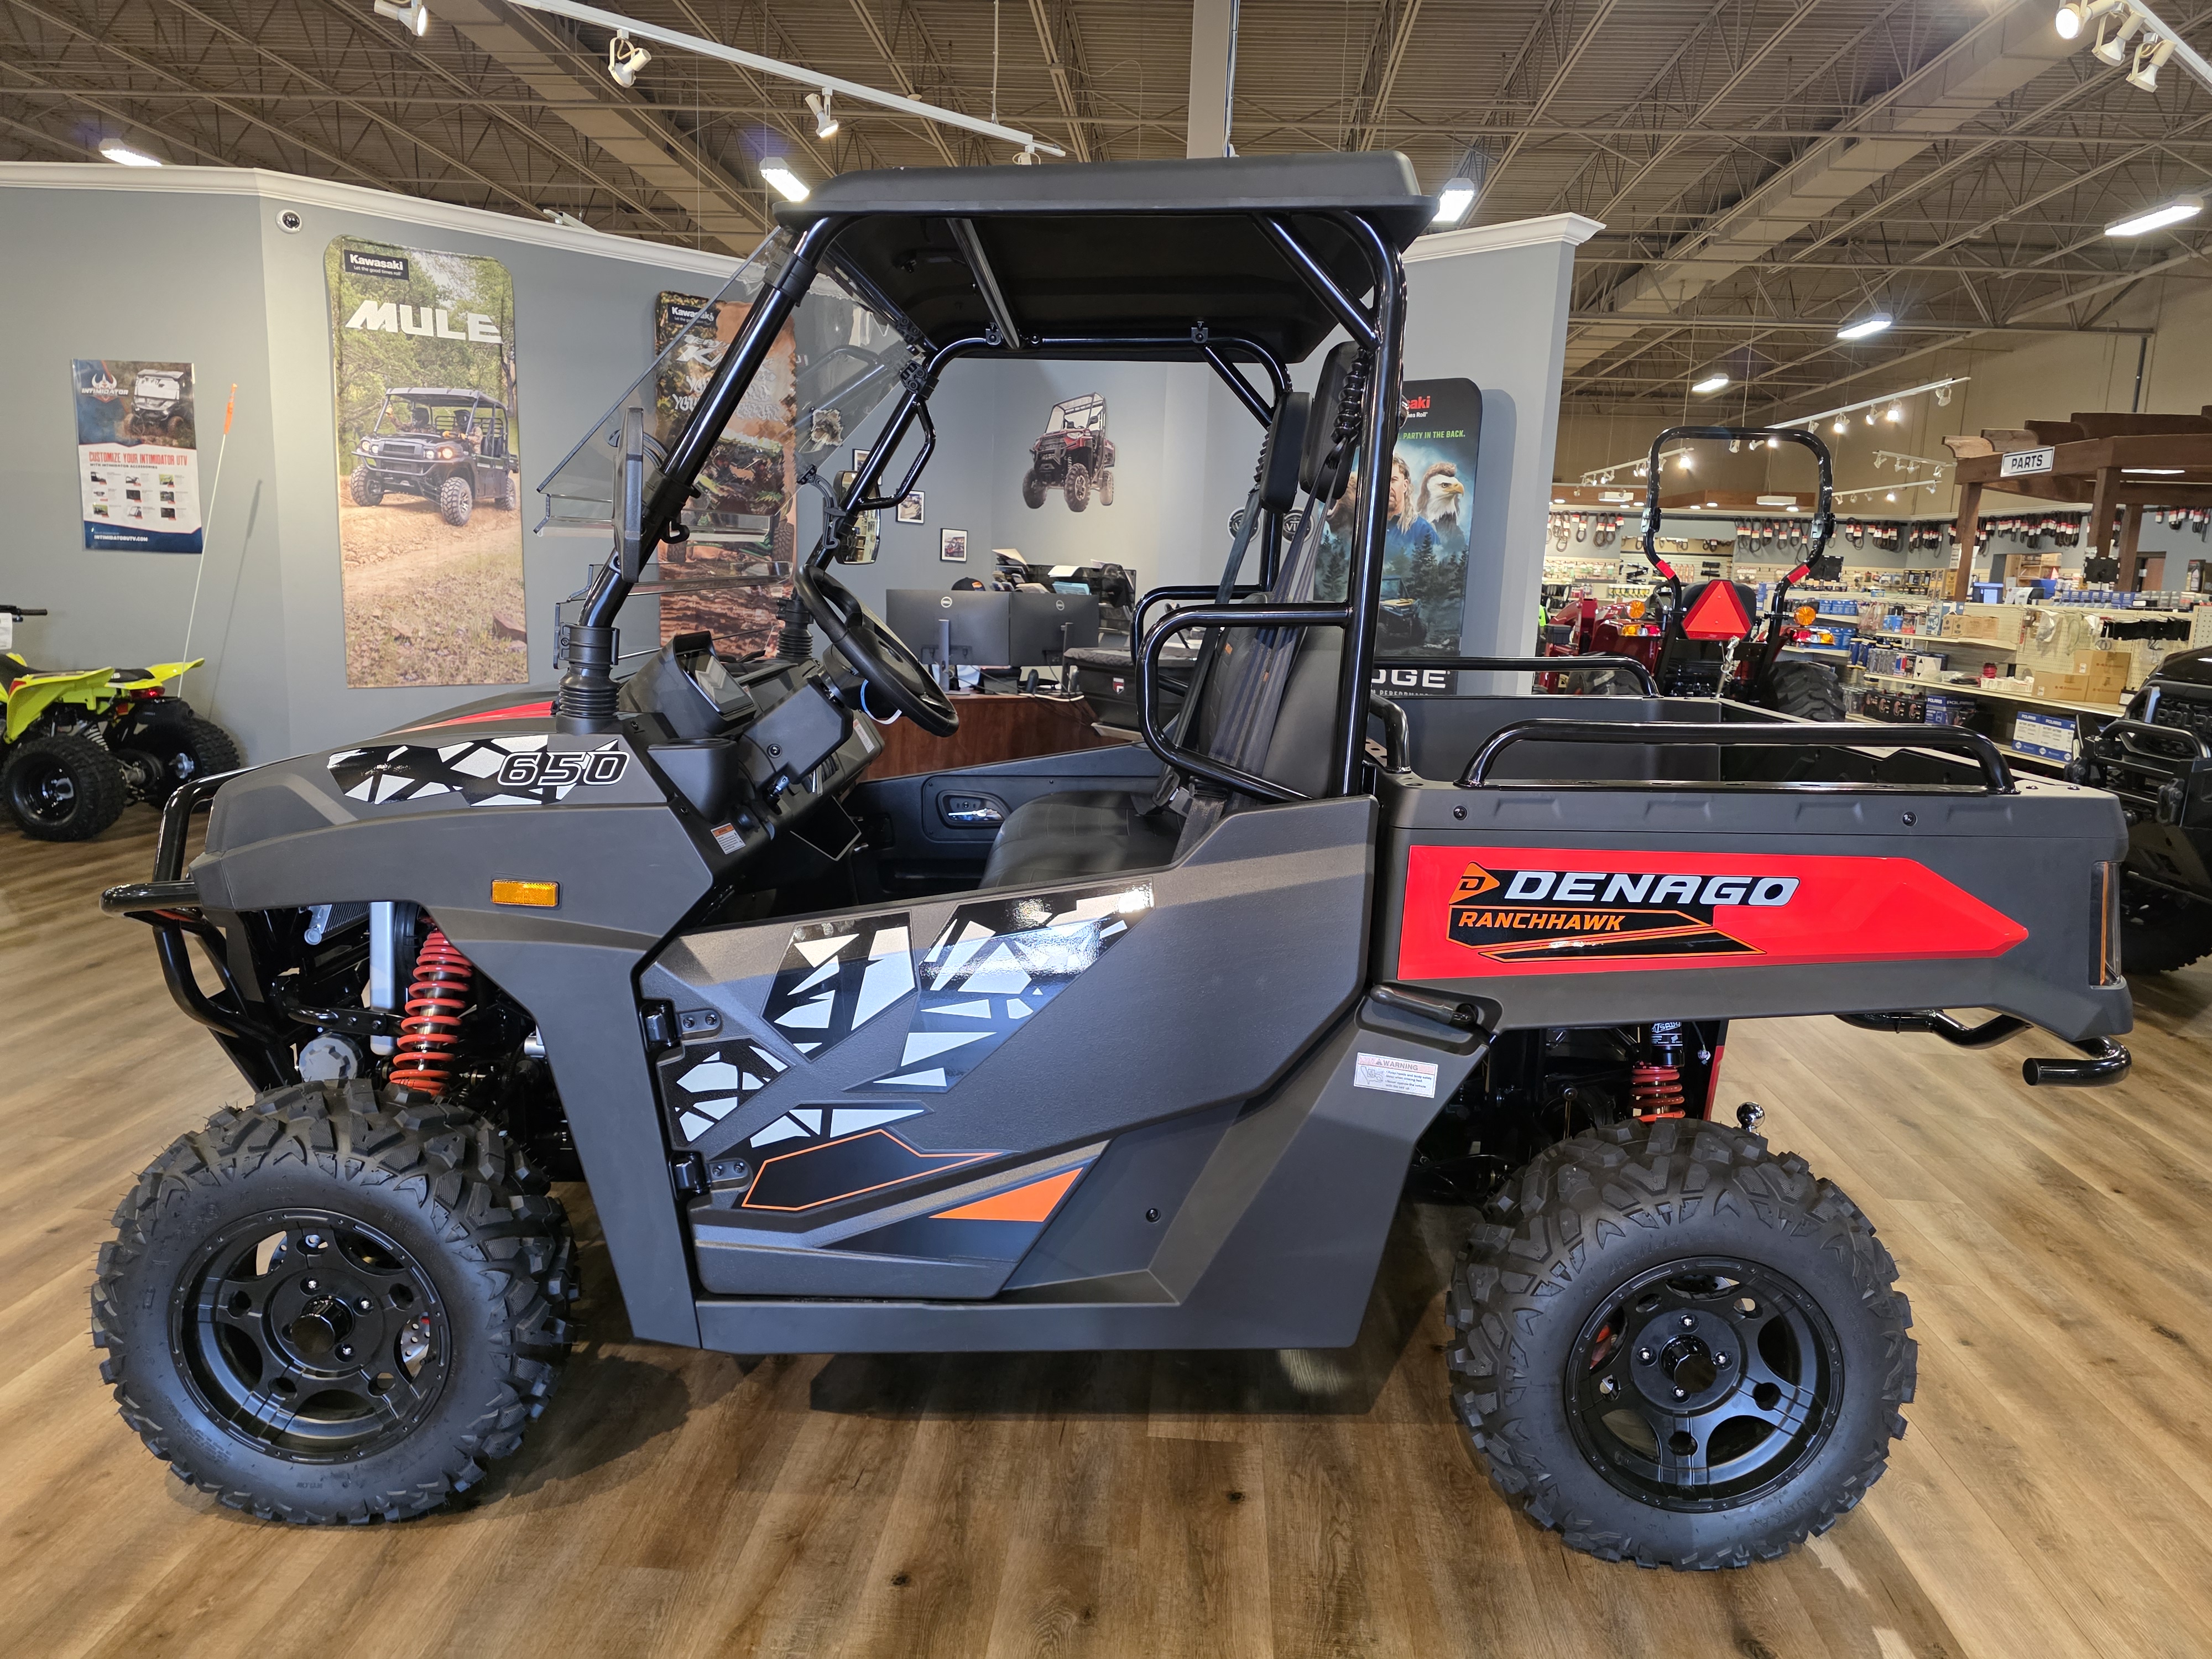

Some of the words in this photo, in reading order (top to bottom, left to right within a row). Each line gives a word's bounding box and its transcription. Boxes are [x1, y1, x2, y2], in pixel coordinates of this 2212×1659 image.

[349, 254, 403, 270] Kawasaki
[345, 300, 502, 344] MULE
[88, 451, 121, 463] CUSTOMIZE
[123, 453, 138, 464] YOUR
[139, 453, 175, 465] INTIMIDATOR
[176, 455, 187, 466] UTV
[2011, 454, 2043, 470] PARTS
[497, 750, 630, 786] 650
[1504, 870, 1800, 906] DENAGO
[1458, 911, 1626, 931] RANCHHAWK
[1383, 1060, 1418, 1071] WARNING
